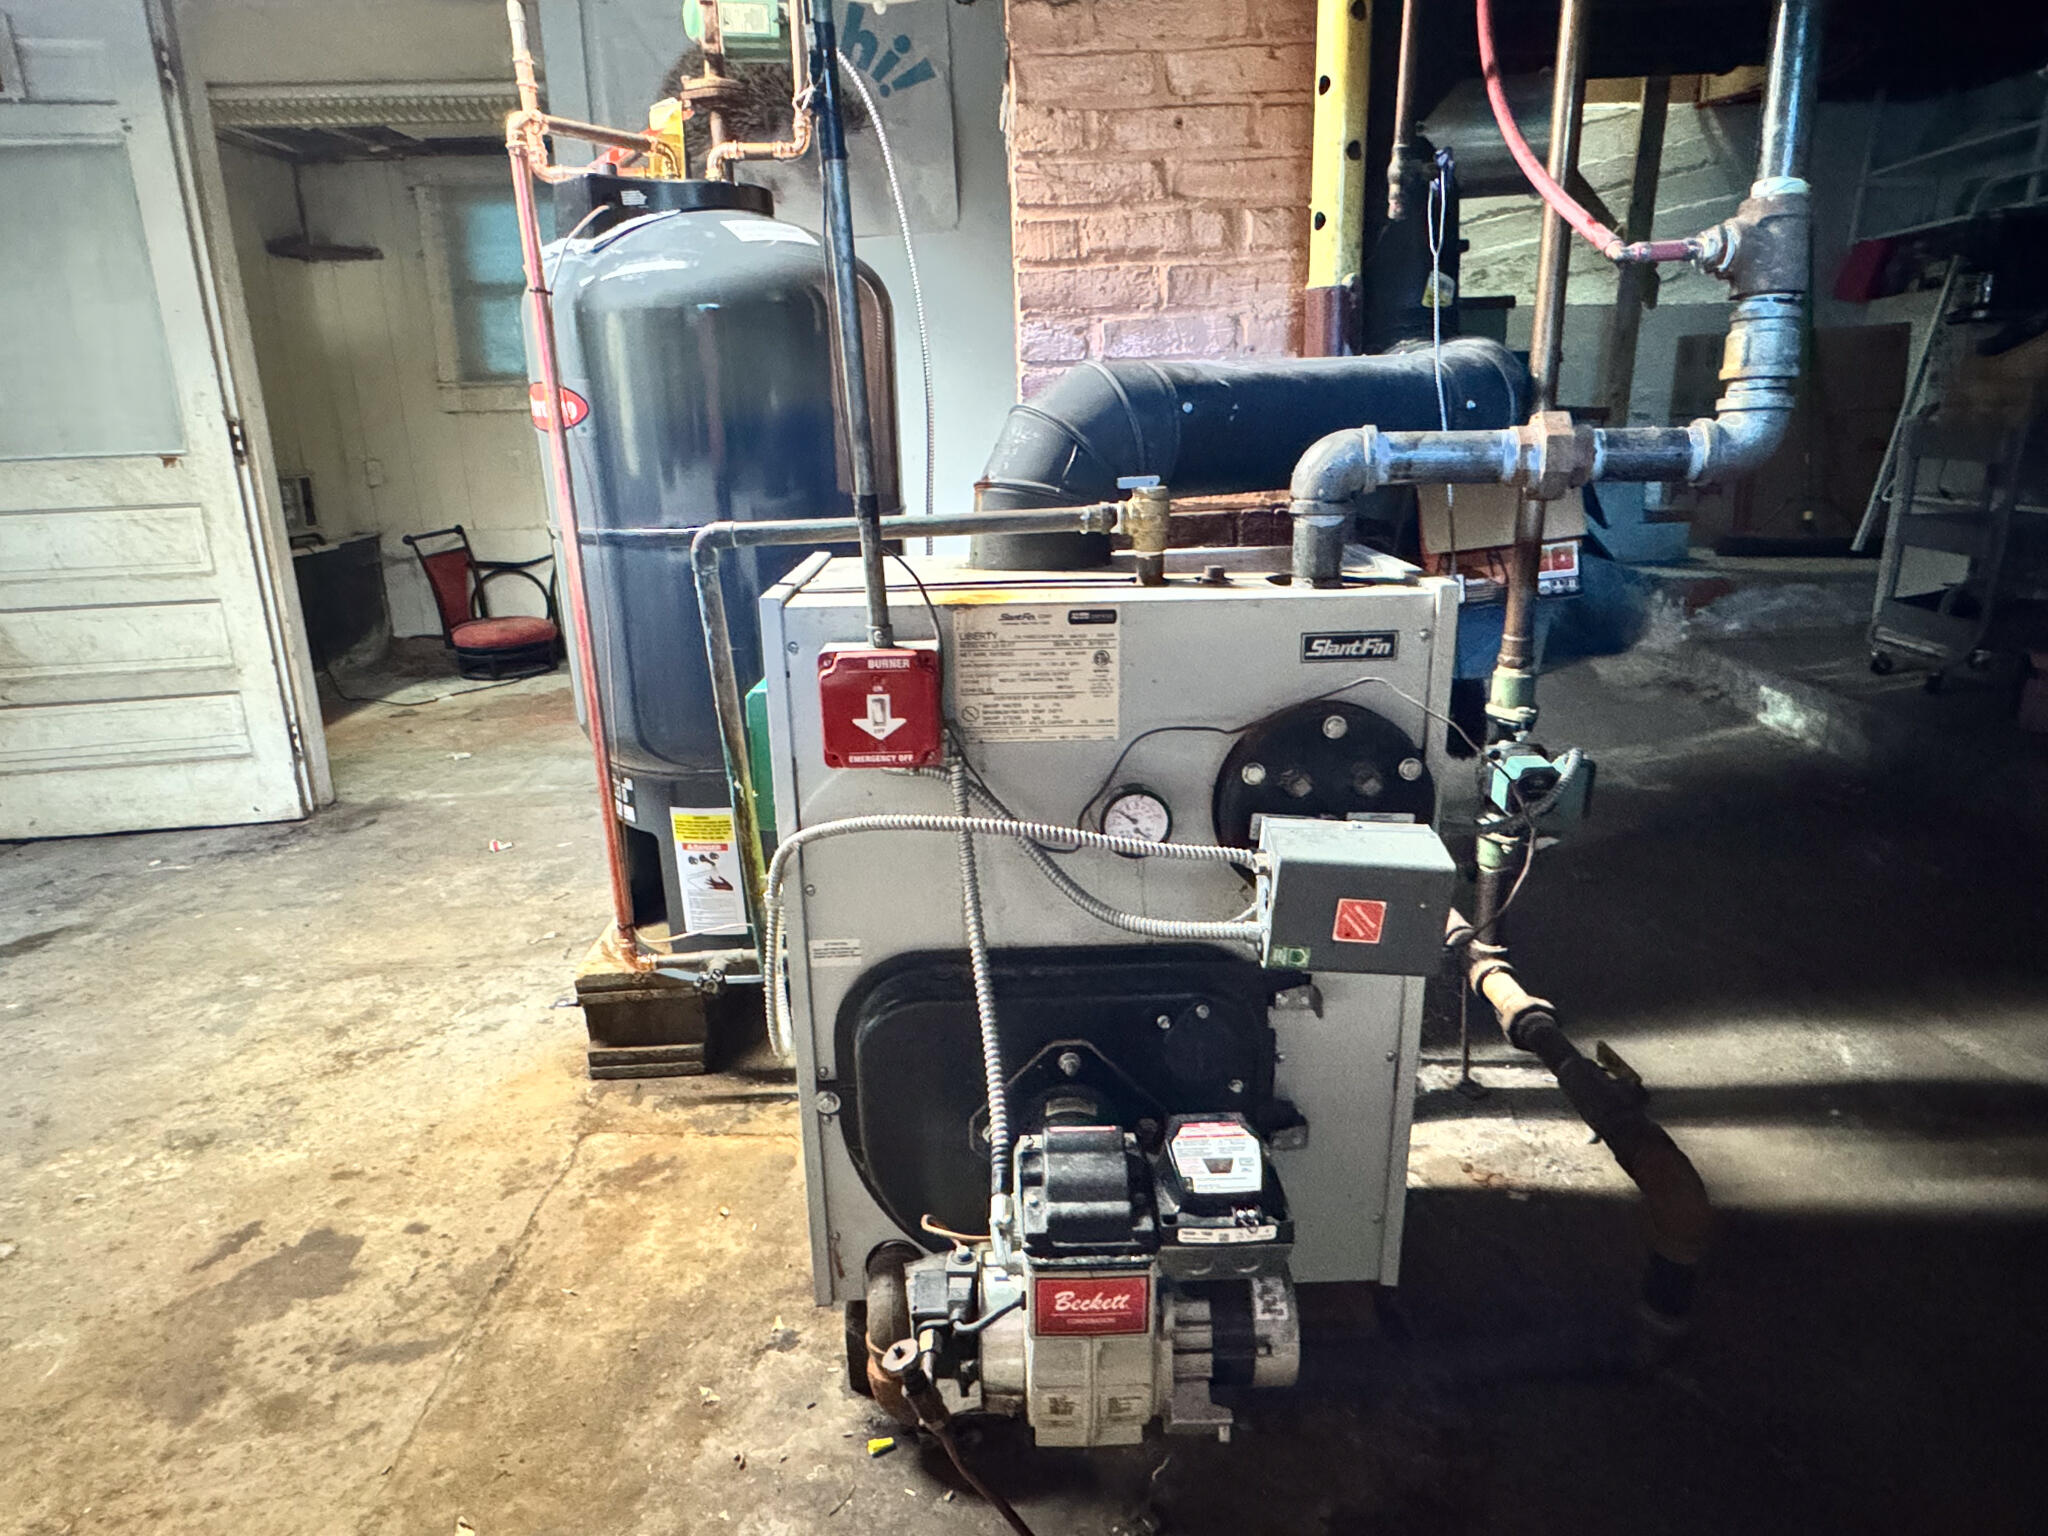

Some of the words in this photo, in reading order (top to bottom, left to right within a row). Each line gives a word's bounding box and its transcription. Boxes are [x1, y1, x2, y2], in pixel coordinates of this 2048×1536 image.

[959, 632, 998, 641] LIBERTY
[867, 658, 910, 669] BURNER
[848, 755, 896, 763] EMERGENCY
[898, 754, 913, 762] OFF
[1054, 1291, 1131, 1311] Beckett
